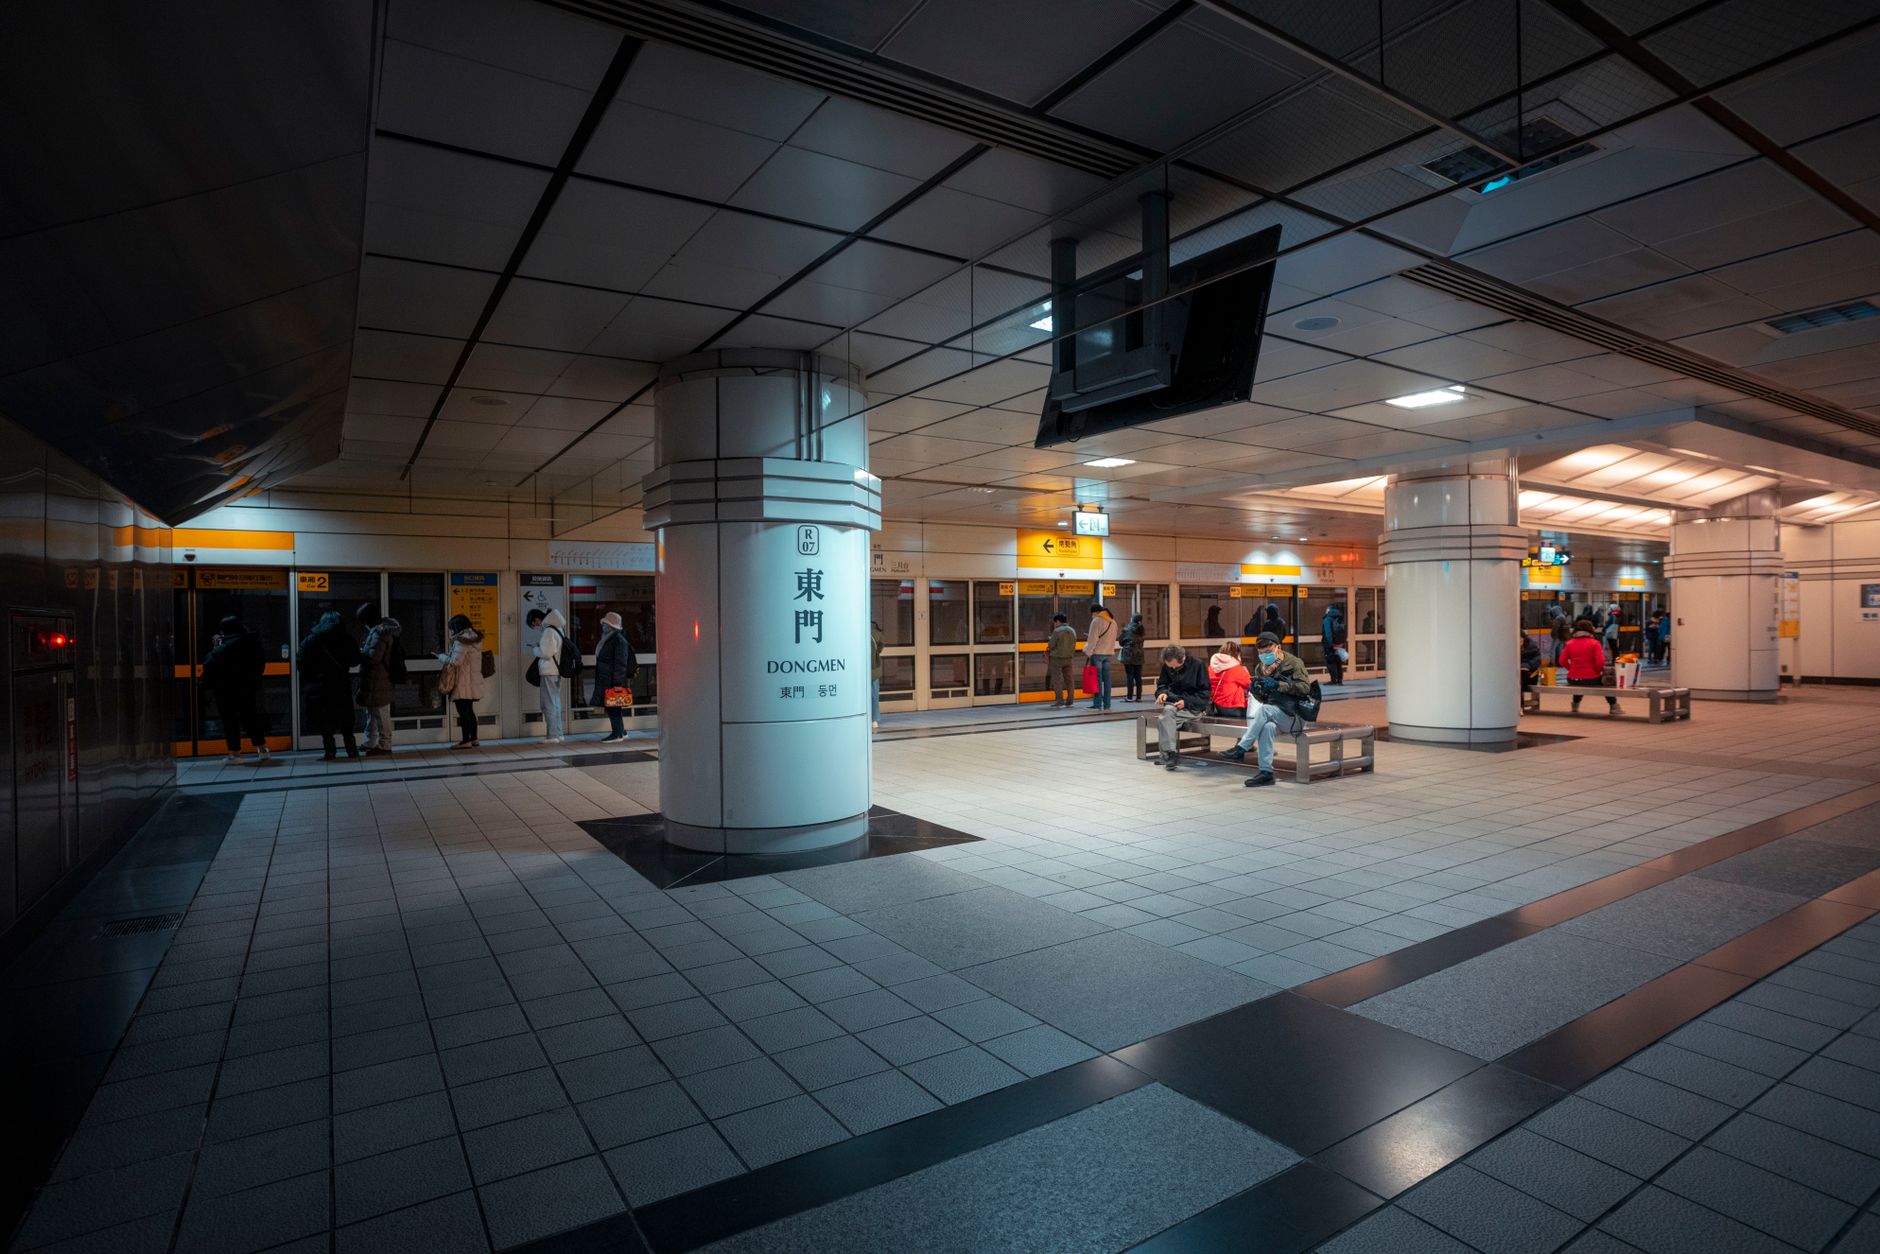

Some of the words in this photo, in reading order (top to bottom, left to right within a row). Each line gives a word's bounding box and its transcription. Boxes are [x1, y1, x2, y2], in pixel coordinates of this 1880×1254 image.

[804, 529, 813, 540] R
[802, 541, 815, 552] 07
[317, 576, 328, 589] 2
[1009, 584, 1014, 594] 3
[793, 567, 825, 645] 東門
[767, 658, 846, 674] DONGMEN
[780, 685, 805, 699] 東門
